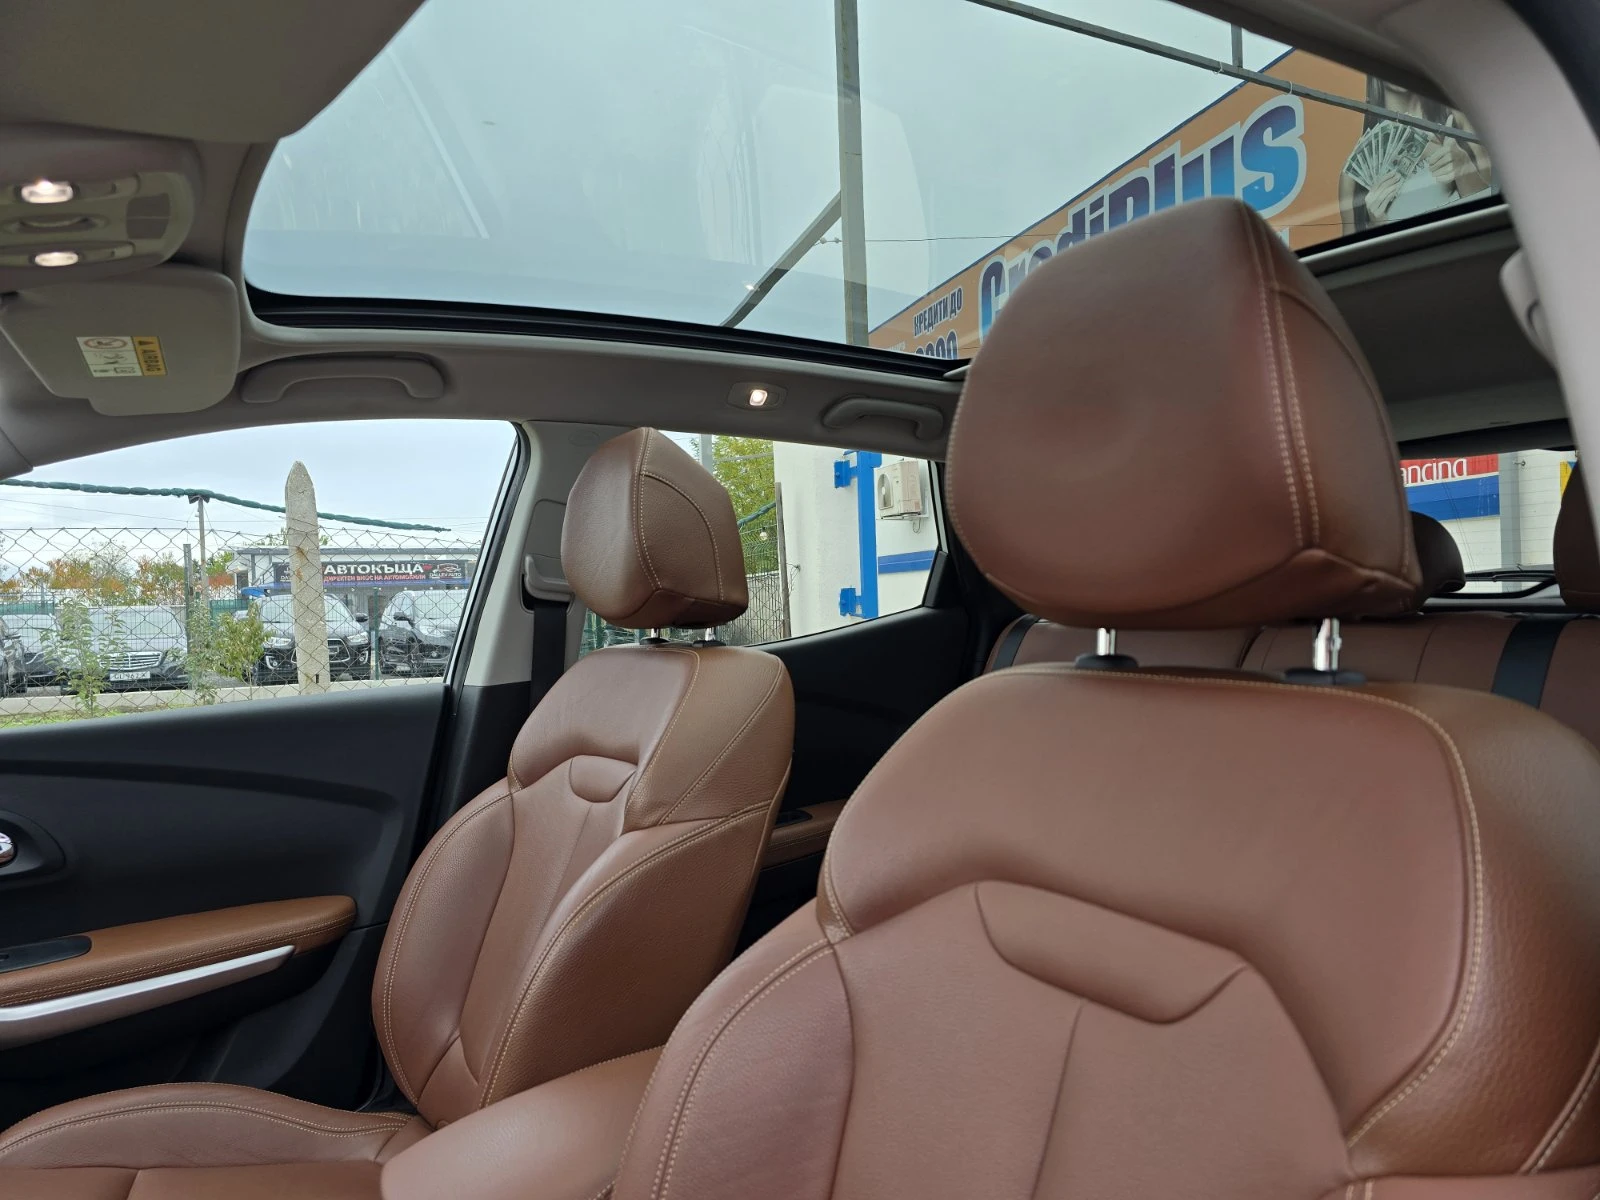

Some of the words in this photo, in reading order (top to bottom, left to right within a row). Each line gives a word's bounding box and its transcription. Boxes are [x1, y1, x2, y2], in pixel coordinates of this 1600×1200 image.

[913, 295, 950, 338] КРЕДИТИ
[949, 286, 963, 320] ДО
[323, 563, 424, 577] АВТОКЪЩА
